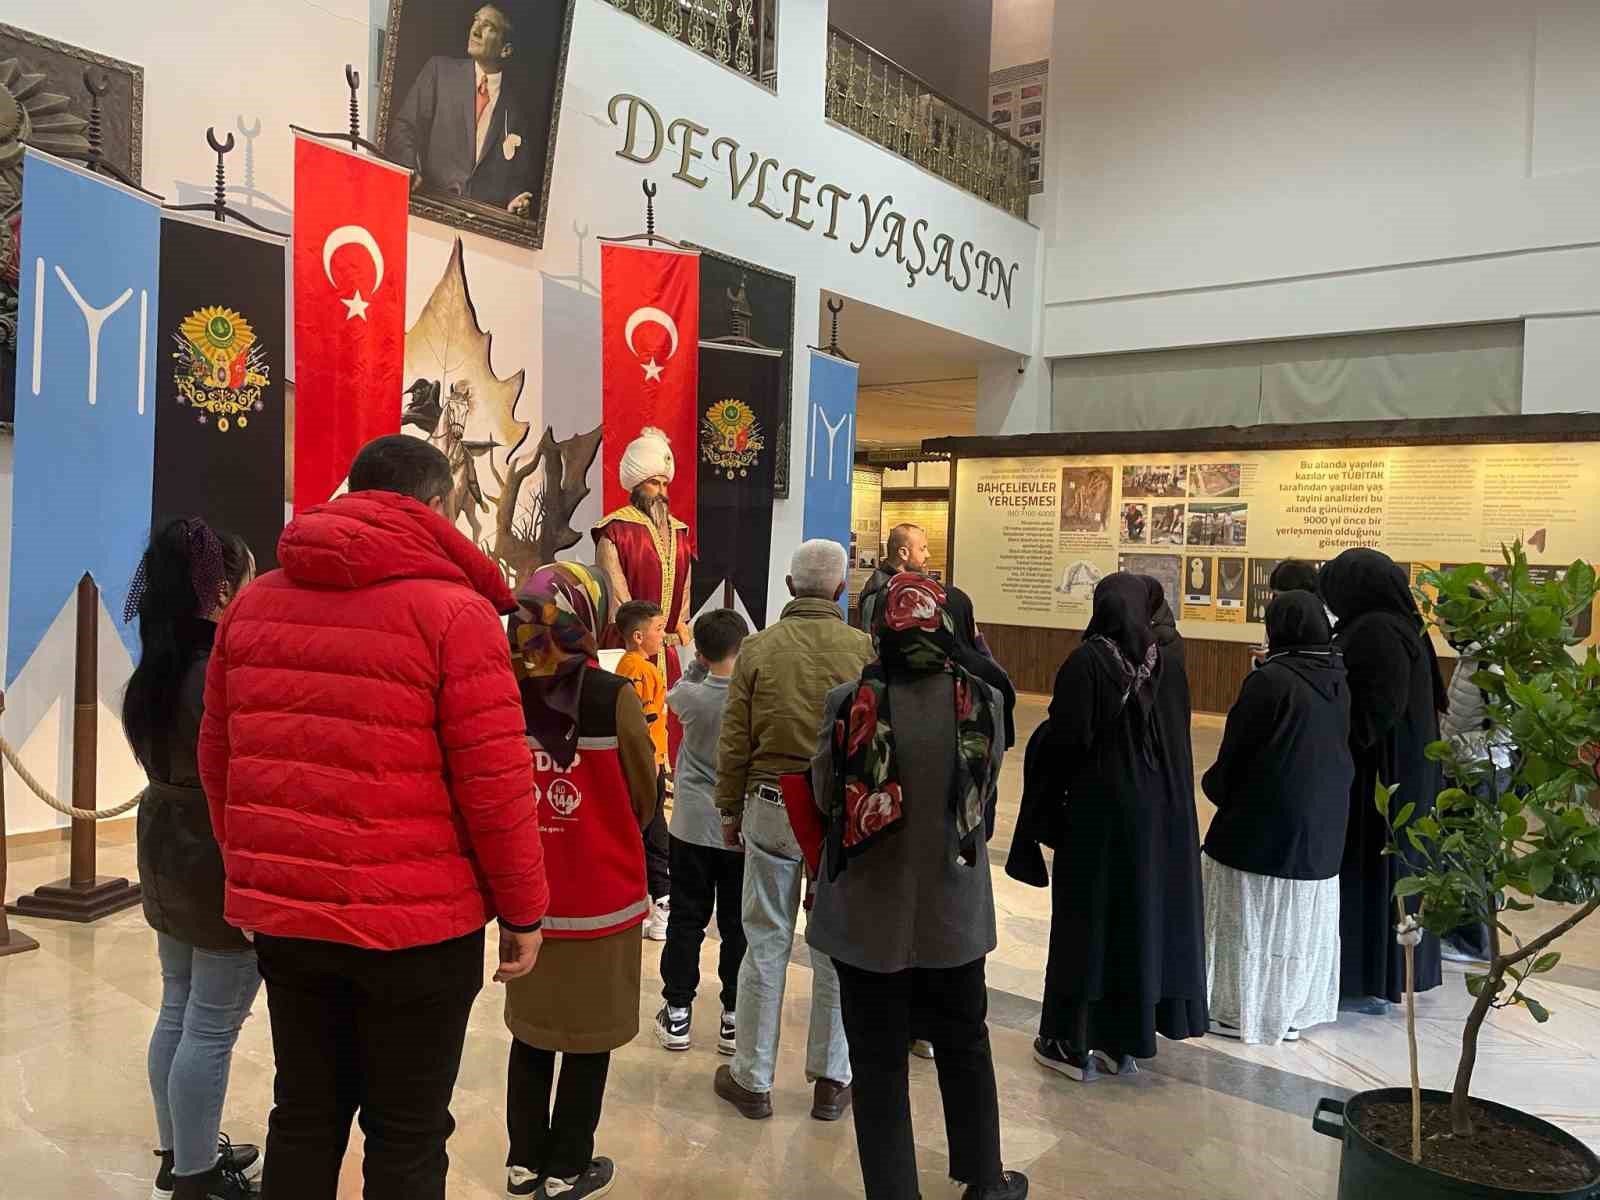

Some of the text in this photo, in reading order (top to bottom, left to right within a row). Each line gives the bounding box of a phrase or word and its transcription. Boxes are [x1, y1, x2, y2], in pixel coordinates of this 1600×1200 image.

[607, 93, 1019, 310] DEVLET YAŞASIN
[1300, 459, 1385, 471] Bu alanda yapılan
[1295, 471, 1326, 480] kazılar
[977, 481, 1057, 495] BAHÇELİEVLER
[1279, 482, 1384, 493] tarafından yapılan yaş
[988, 495, 1056, 510] YERLEŞMESİ
[1296, 494, 1383, 504] tayini analizleri bu
[1285, 504, 1383, 516] alanda günümüzden
[1303, 516, 1383, 527] 9000 yıl önce bir
[1275, 527, 1382, 539] yerleşmenin olduğunu
